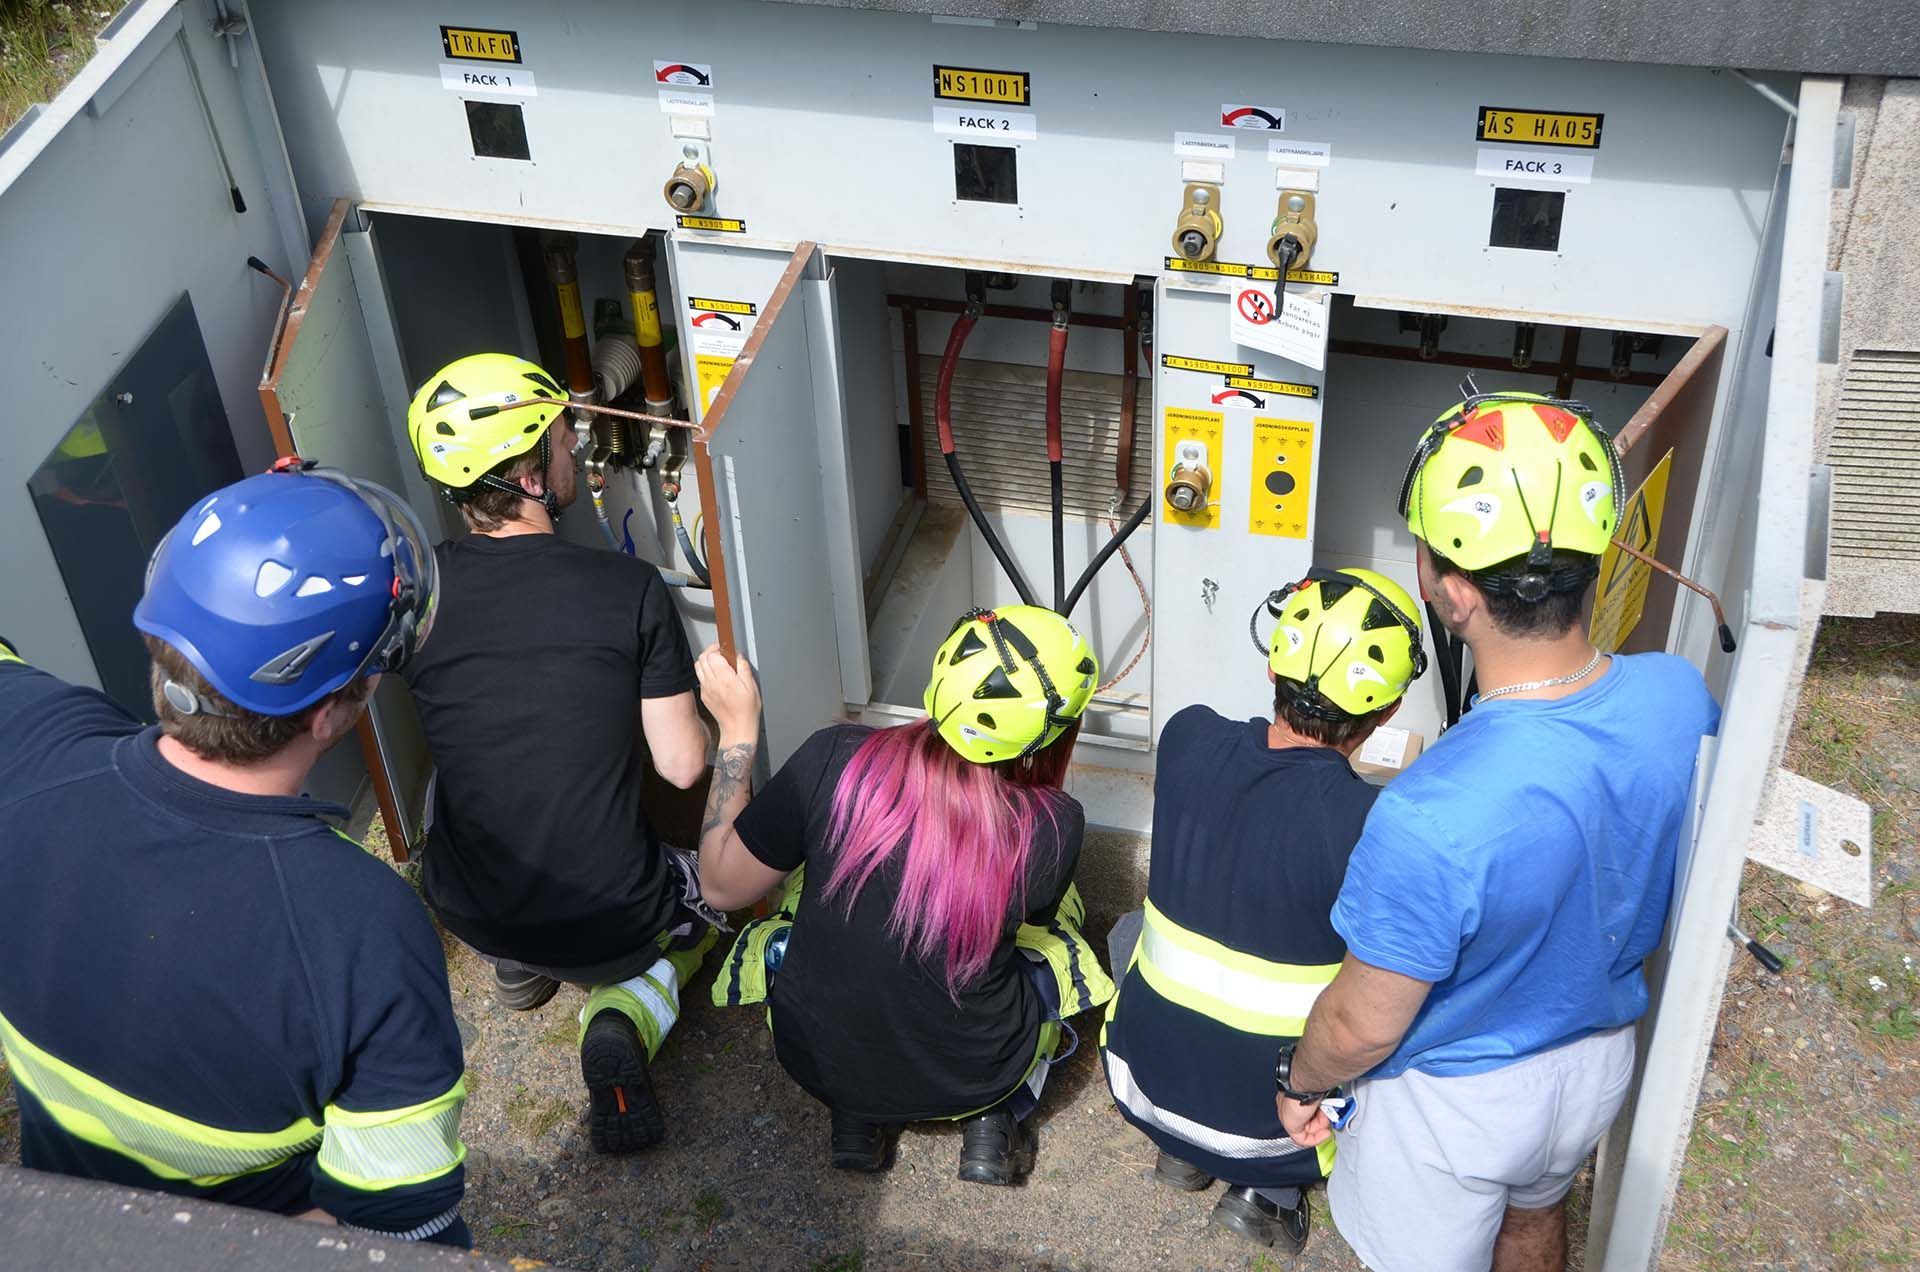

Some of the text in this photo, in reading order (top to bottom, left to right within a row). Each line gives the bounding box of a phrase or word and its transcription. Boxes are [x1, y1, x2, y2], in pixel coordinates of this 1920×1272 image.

[450, 34, 511, 55] TRAFO
[463, 73, 512, 87] FACK 1
[942, 73, 1020, 97] NS1001
[959, 116, 1010, 131] FACK 2
[1487, 112, 1593, 140] ÅS HA05
[1505, 159, 1562, 174] FACK 3
